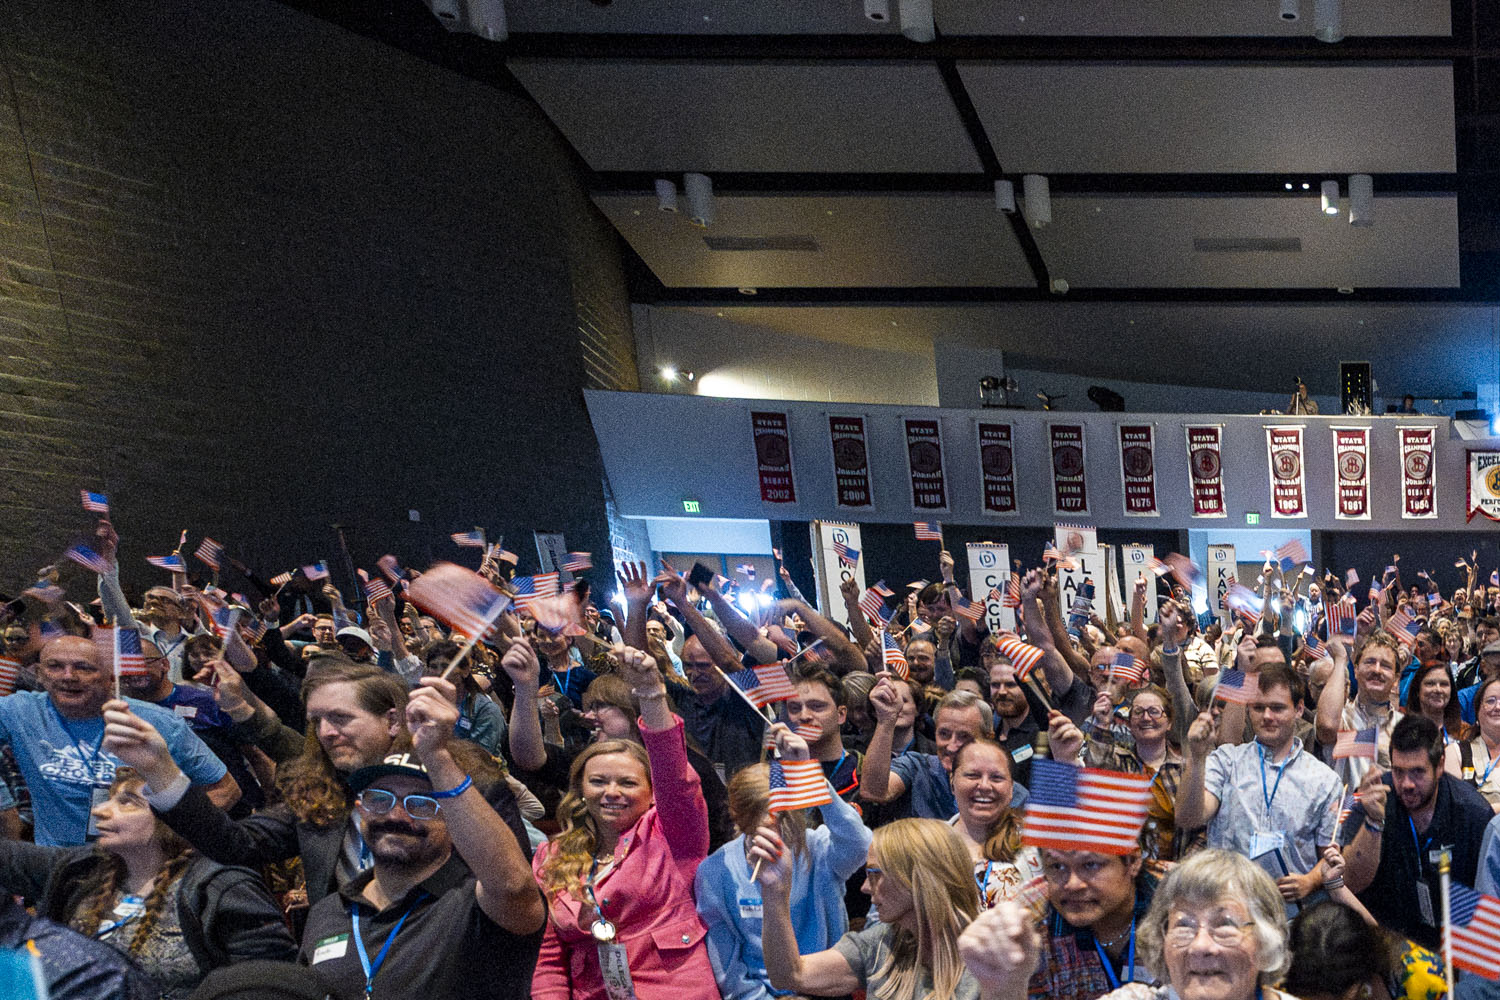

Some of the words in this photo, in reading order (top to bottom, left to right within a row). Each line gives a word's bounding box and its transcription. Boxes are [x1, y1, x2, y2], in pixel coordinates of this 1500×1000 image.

[759, 464, 789, 472] JORDAN
[837, 468, 866, 476] JORDAN
[912, 471, 942, 479] JORDAN
[984, 474, 1012, 482] JORDAN
[1055, 474, 1083, 482] JORDAN
[1194, 477, 1219, 485] JORDAN
[1274, 478, 1300, 486] JORDAN
[767, 489, 789, 499] 2002
[1277, 488, 1297, 496] DRAMA
[1061, 497, 1081, 507] 1977
[685, 502, 699, 512] EXIT
[1247, 514, 1258, 523] EXIT
[1217, 568, 1228, 610] KANE
[384, 753, 428, 772] SL
